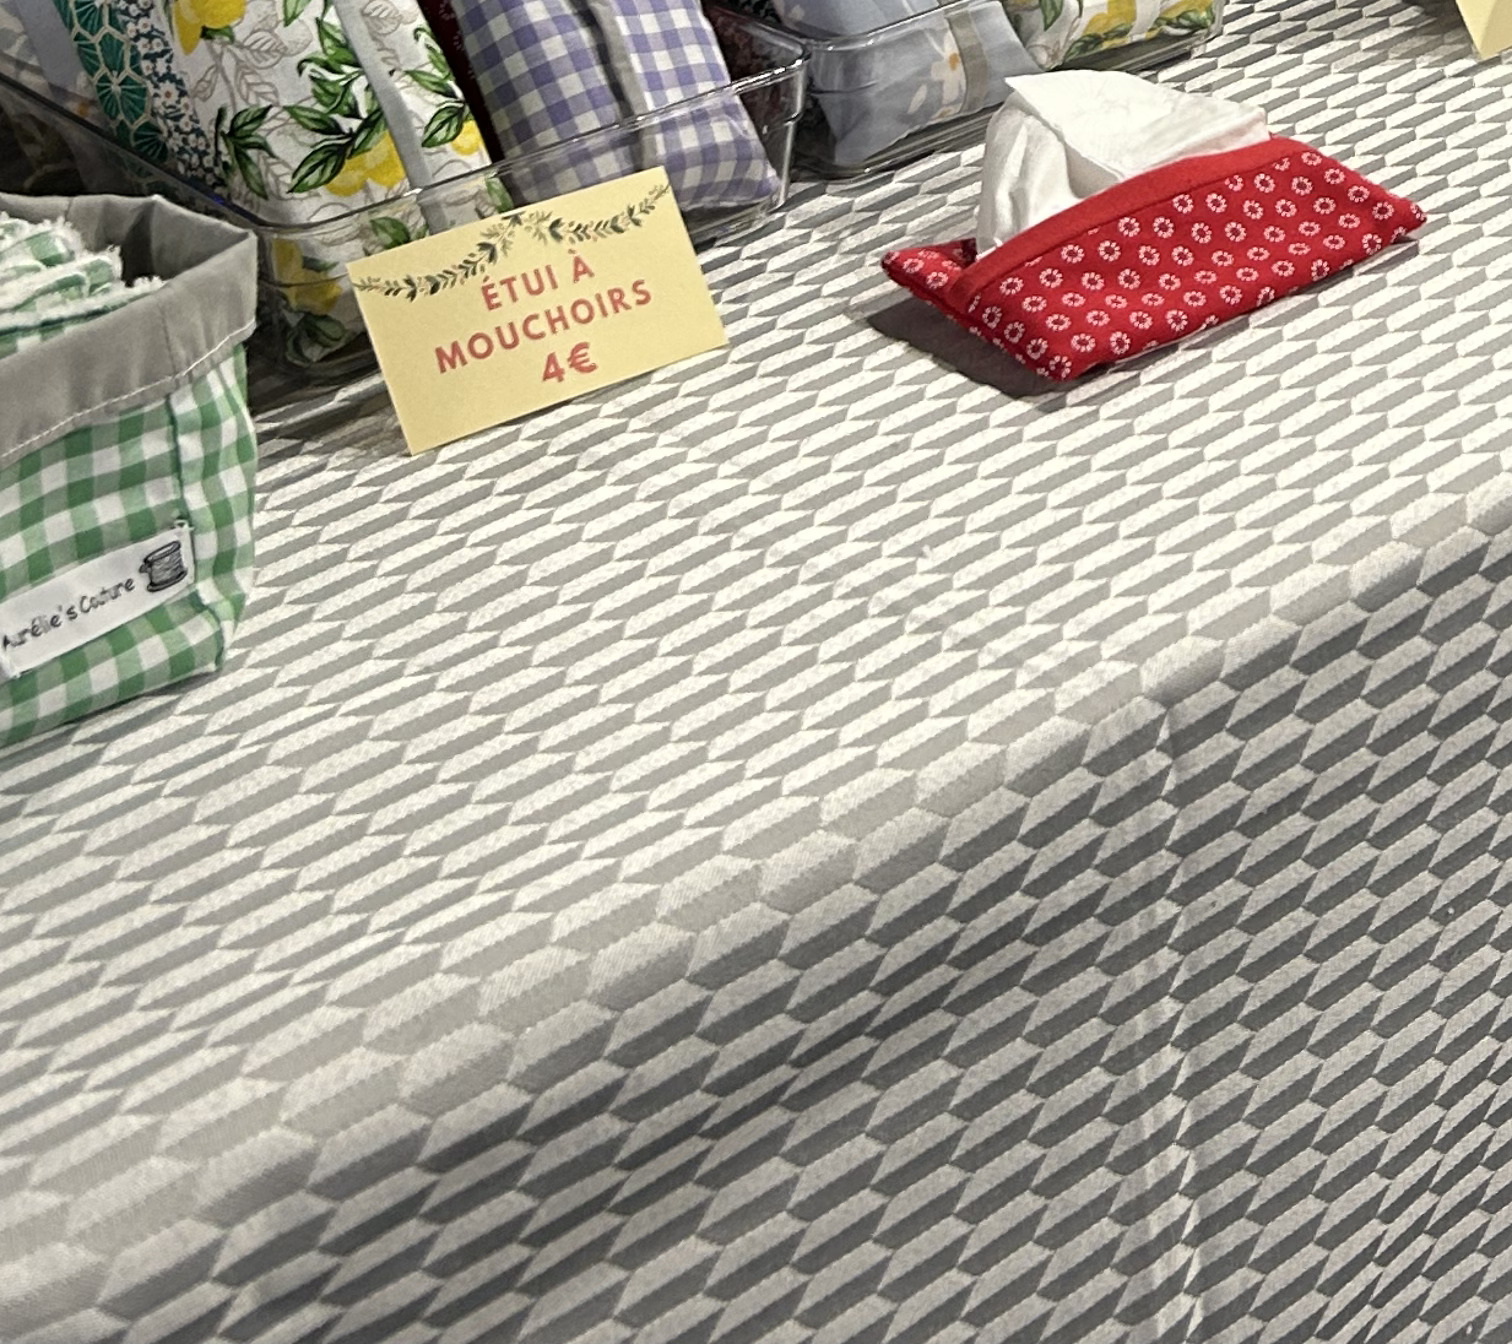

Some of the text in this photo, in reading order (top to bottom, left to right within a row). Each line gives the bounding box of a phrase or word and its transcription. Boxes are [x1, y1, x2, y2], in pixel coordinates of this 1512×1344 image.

[481, 249, 595, 311] ÉTUI À
[434, 279, 652, 374] MOUCHOIRS
[542, 341, 598, 384] 4€
